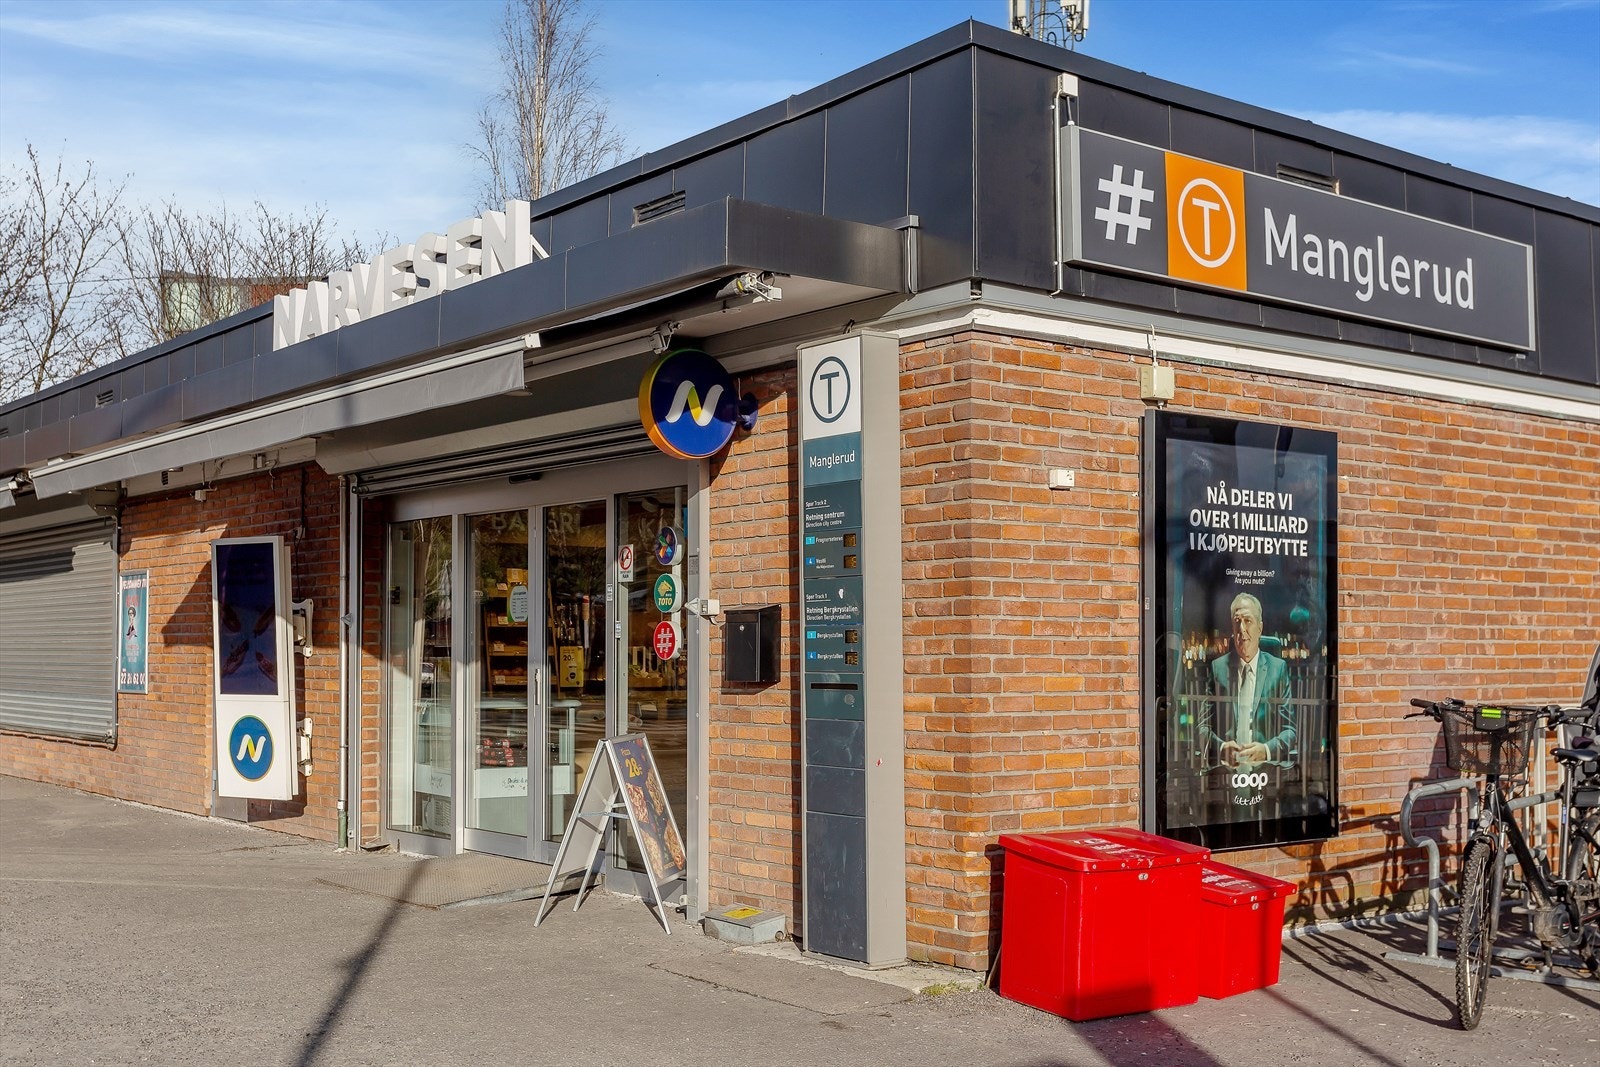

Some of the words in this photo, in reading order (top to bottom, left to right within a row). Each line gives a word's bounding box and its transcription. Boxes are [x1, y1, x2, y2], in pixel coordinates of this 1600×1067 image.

[1264, 207, 1474, 310] Manglerud
[273, 199, 531, 352] NARVESEN
[809, 450, 855, 469] Manglerud
[1206, 480, 1229, 506] NÅ
[1231, 488, 1275, 510] DELER
[1278, 492, 1293, 511] VI
[805, 513, 824, 522] Retning
[824, 511, 845, 519] sentrum
[1189, 508, 1230, 529] OVER
[1232, 511, 1239, 529] 1
[1241, 513, 1308, 535] MILLIARD
[1189, 532, 1195, 550] I
[1197, 532, 1308, 557] KJØPEUTBYTTE
[1225, 568, 1241, 577] Giving
[1240, 570, 1253, 578] away
[1257, 569, 1275, 578] billion?
[1241, 578, 1251, 586] you
[1252, 577, 1266, 585] nuts?
[657, 597, 673, 606] TOTO
[806, 607, 824, 615] Retning
[824, 605, 858, 614] Bergkrystallen
[1231, 772, 1268, 790] coop
